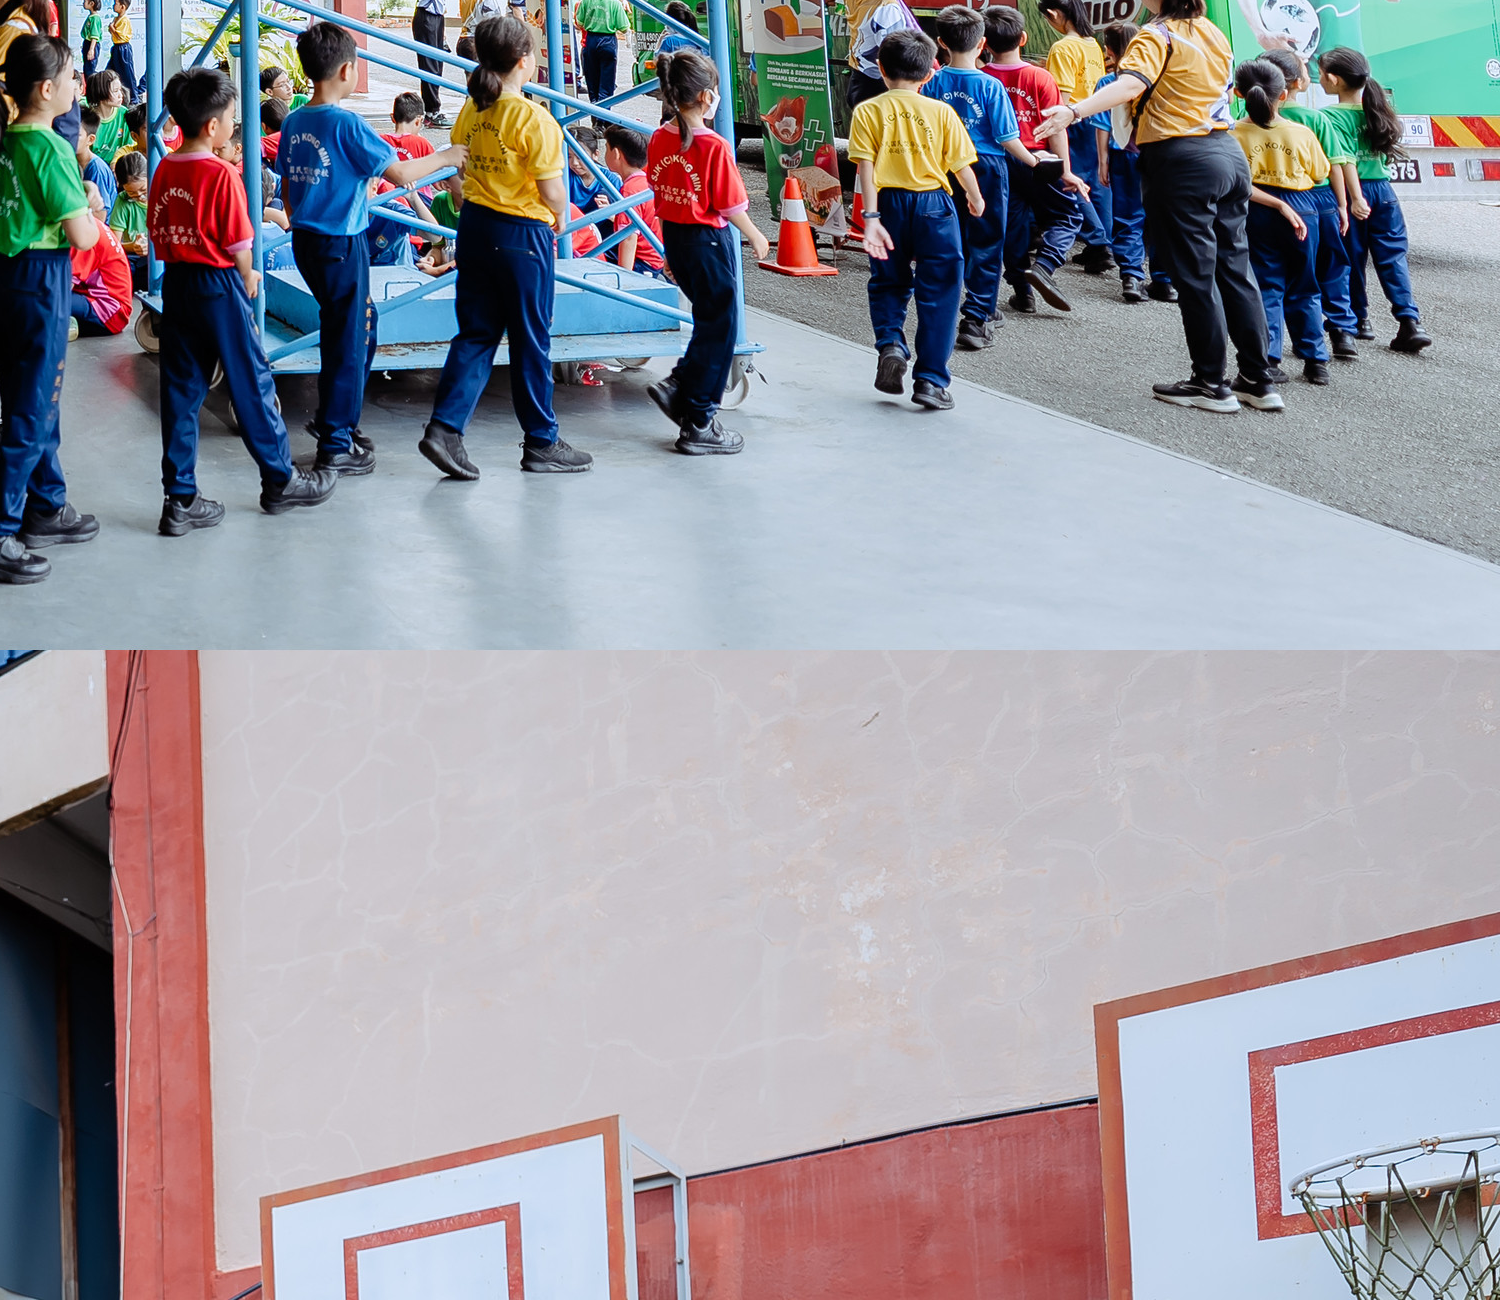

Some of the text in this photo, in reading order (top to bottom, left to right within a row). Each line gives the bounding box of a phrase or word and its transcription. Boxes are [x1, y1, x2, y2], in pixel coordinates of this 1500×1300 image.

[767, 74, 826, 86] BERSAMA SECAWAN MILO
[953, 91, 984, 119] KONG MIN
[1025, 96, 1039, 110] MIN
[899, 110, 924, 127] KONG
[1411, 124, 1423, 135] 90
[302, 132, 321, 148] KONG
[318, 147, 332, 167] MIN
[1265, 141, 1292, 157] KONG
[781, 156, 800, 168] MILO
[651, 156, 702, 192] SJK (C) MIN
